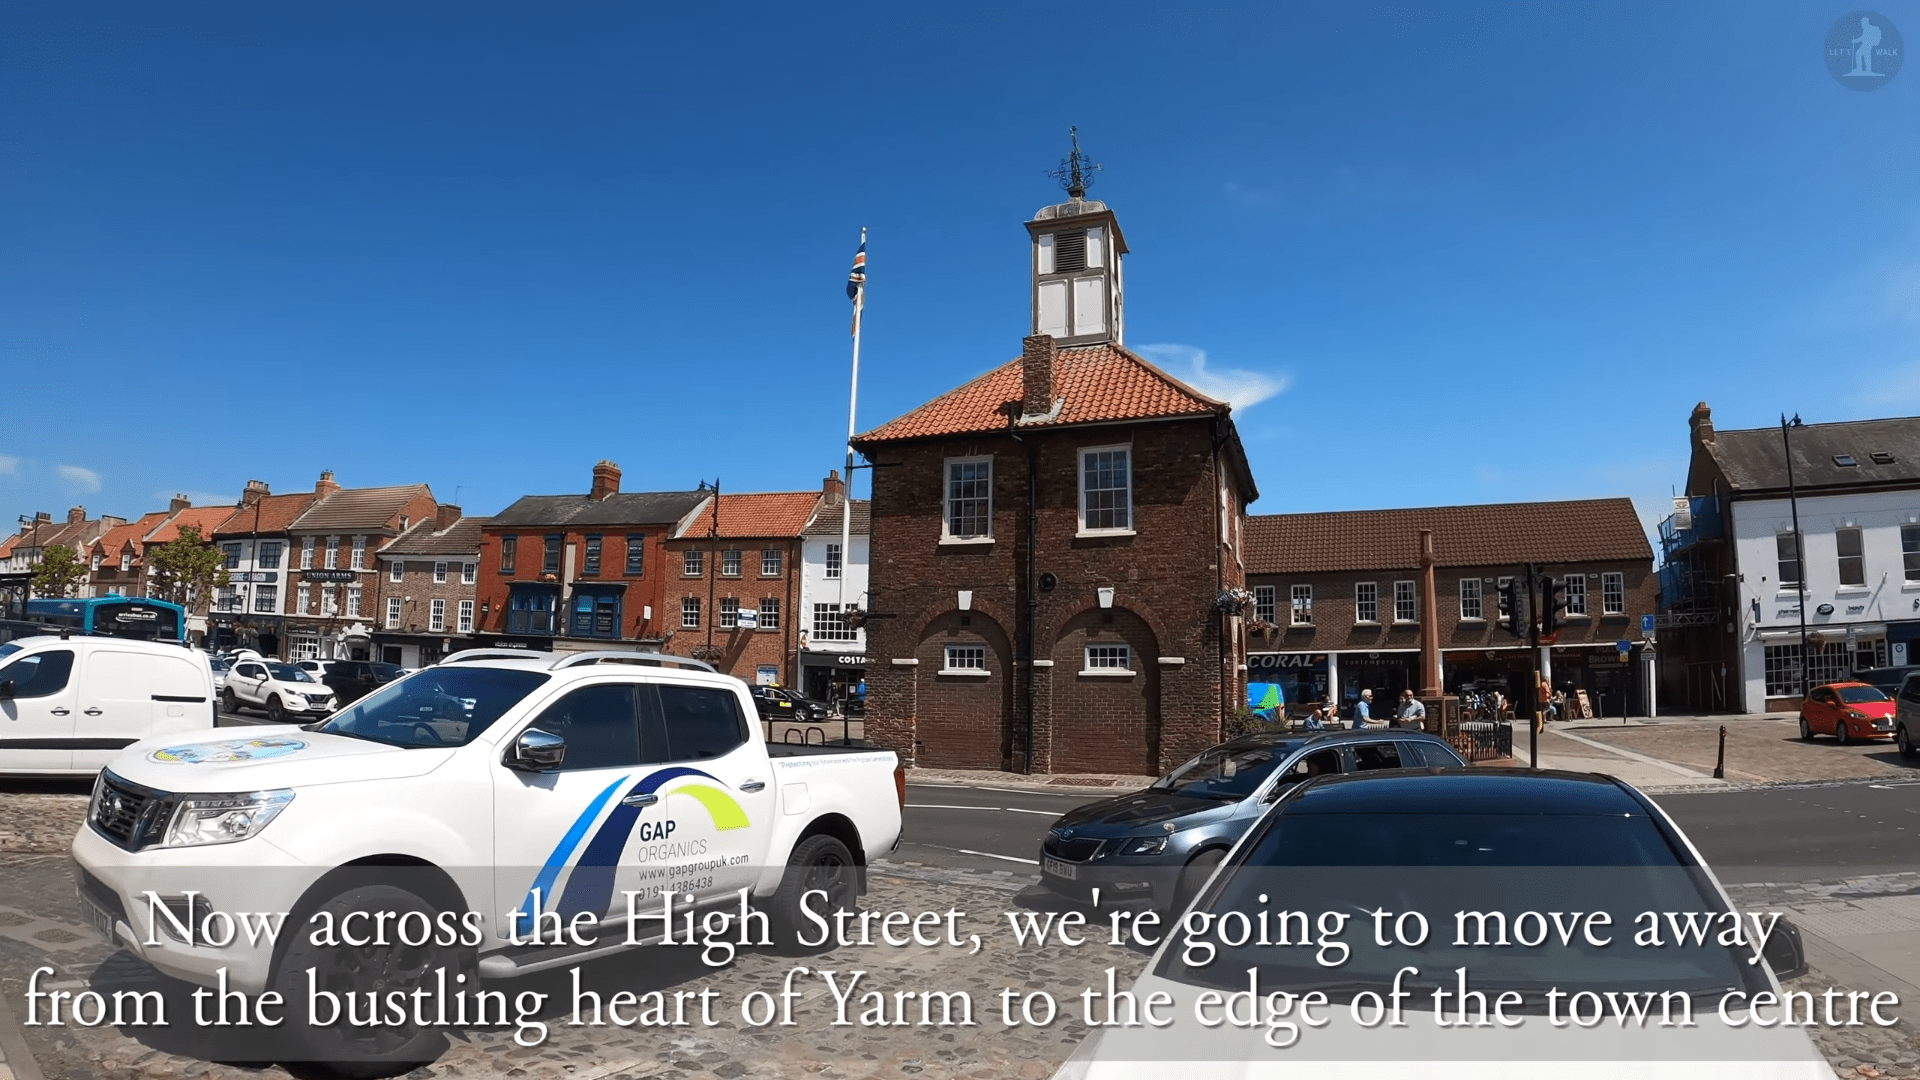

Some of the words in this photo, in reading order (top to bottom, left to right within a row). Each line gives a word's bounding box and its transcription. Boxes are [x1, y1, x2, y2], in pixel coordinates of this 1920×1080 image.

[306, 572, 328, 580] UNION
[330, 572, 352, 580] ARMS
[838, 656, 866, 665] COSTA
[1248, 655, 1314, 668] CORAL
[640, 820, 676, 842] GAP
[638, 839, 707, 863] ORGANICS
[639, 854, 749, 881] www.gapgroupuk.com
[640, 885, 665, 900] 0191
[671, 876, 713, 894] 4386438
